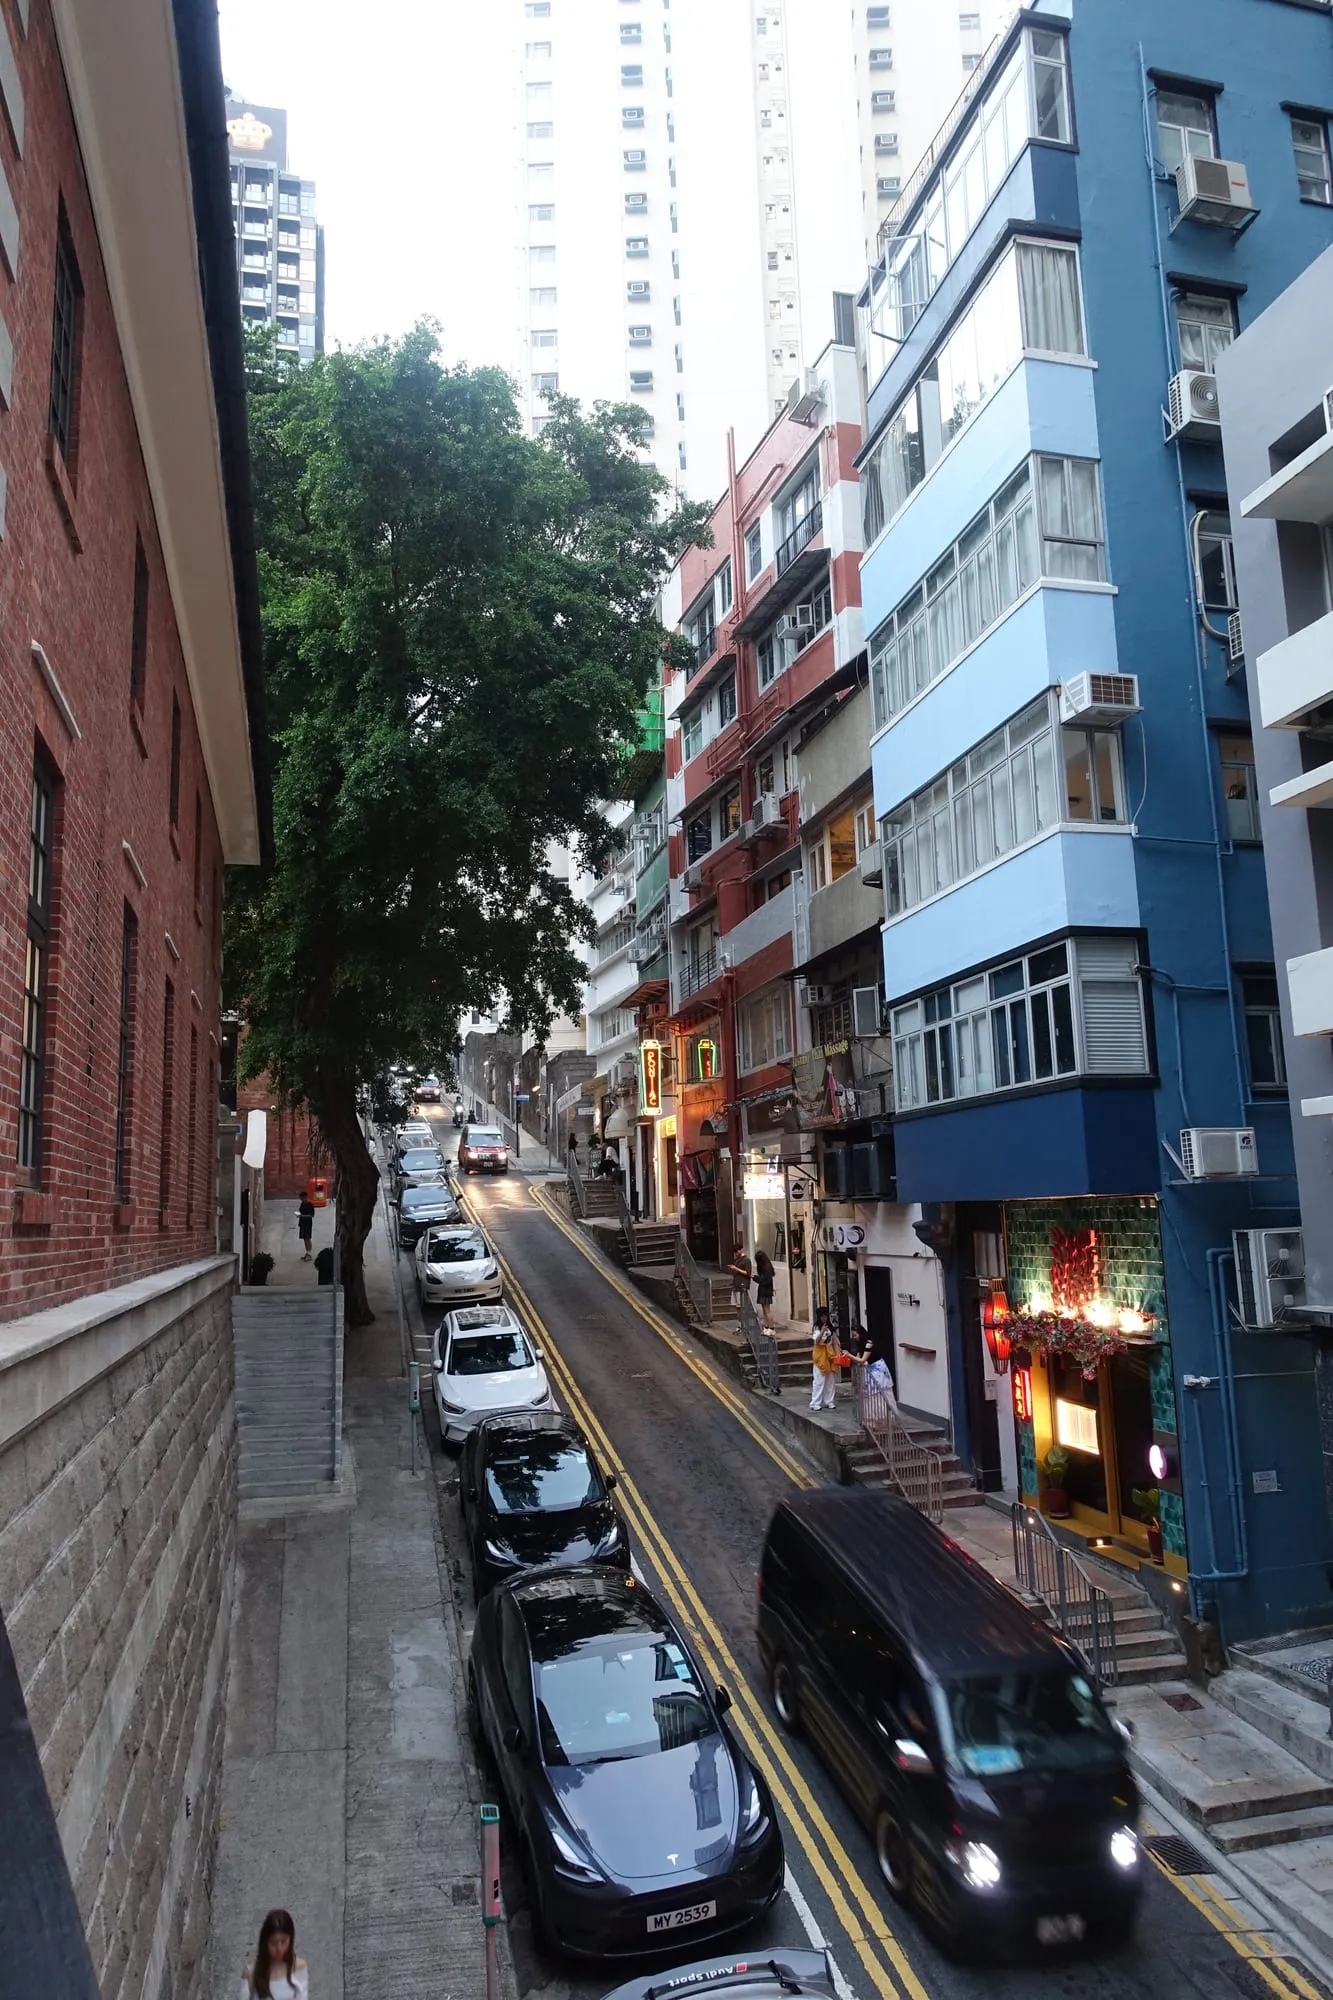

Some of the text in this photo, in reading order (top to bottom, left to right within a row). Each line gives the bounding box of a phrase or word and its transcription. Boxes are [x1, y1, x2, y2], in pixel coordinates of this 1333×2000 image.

[824, 1039, 849, 1057] Massage
[647, 1051, 657, 1106] PONTIAC
[653, 1904, 710, 1929] MY 2539
[668, 1966, 734, 1987] Audi Sport
